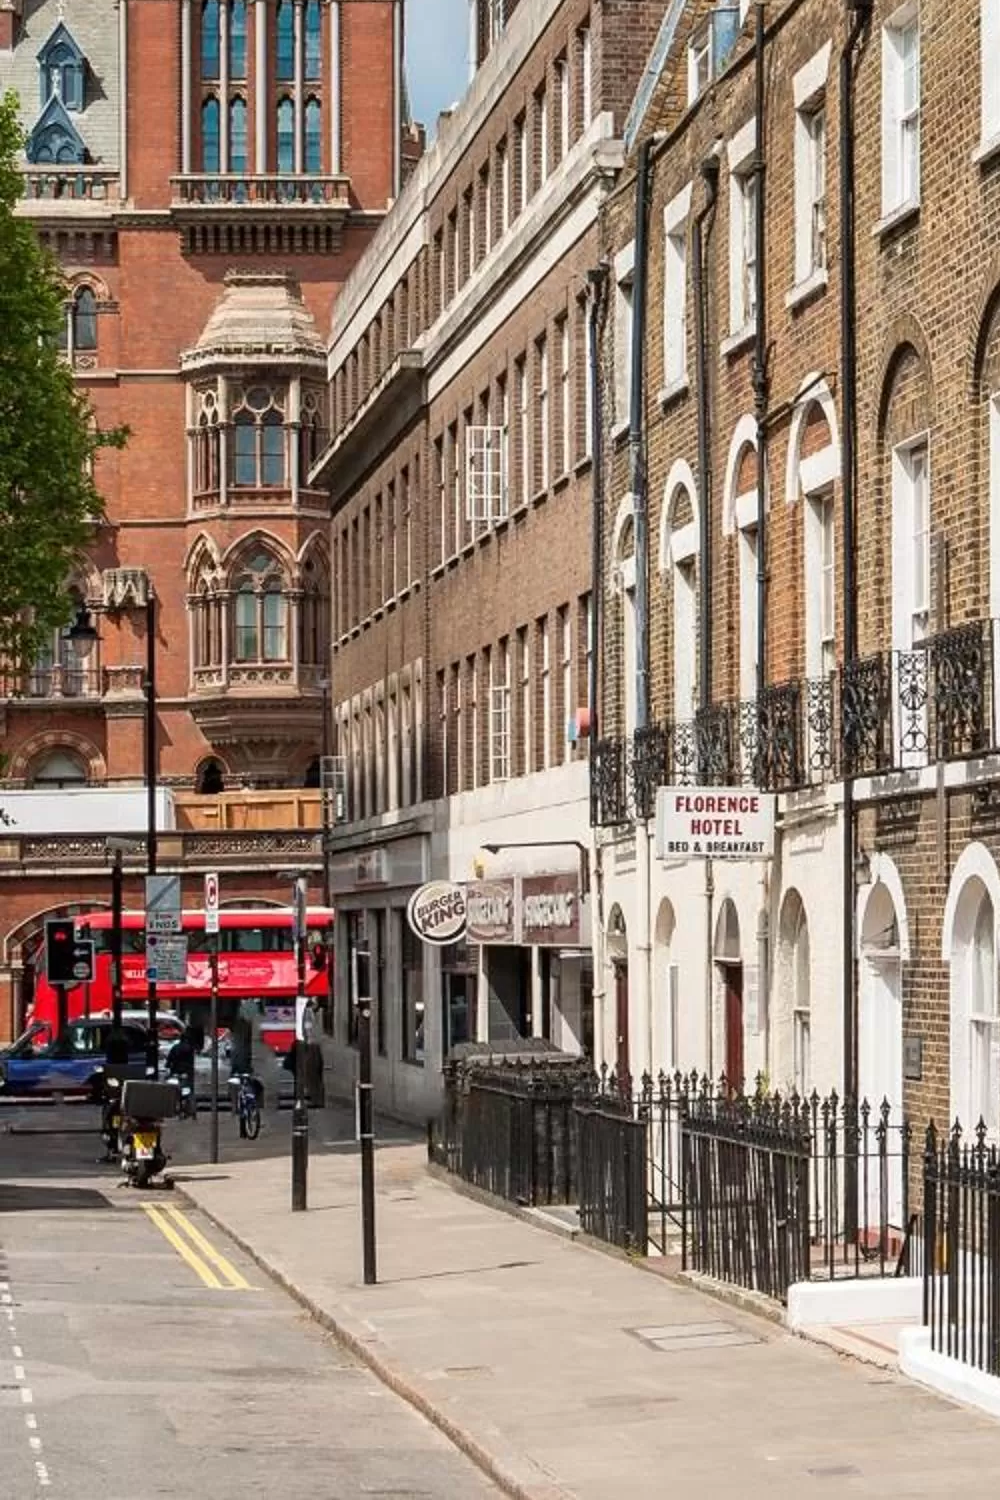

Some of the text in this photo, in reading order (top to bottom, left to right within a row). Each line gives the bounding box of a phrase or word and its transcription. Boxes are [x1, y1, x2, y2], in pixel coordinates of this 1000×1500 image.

[675, 796, 759, 813] FLORENCE
[691, 819, 743, 836] HOTEL
[668, 841, 765, 853] BED & BREAKFAST
[417, 891, 462, 918] BURGER
[420, 901, 466, 933] KING
